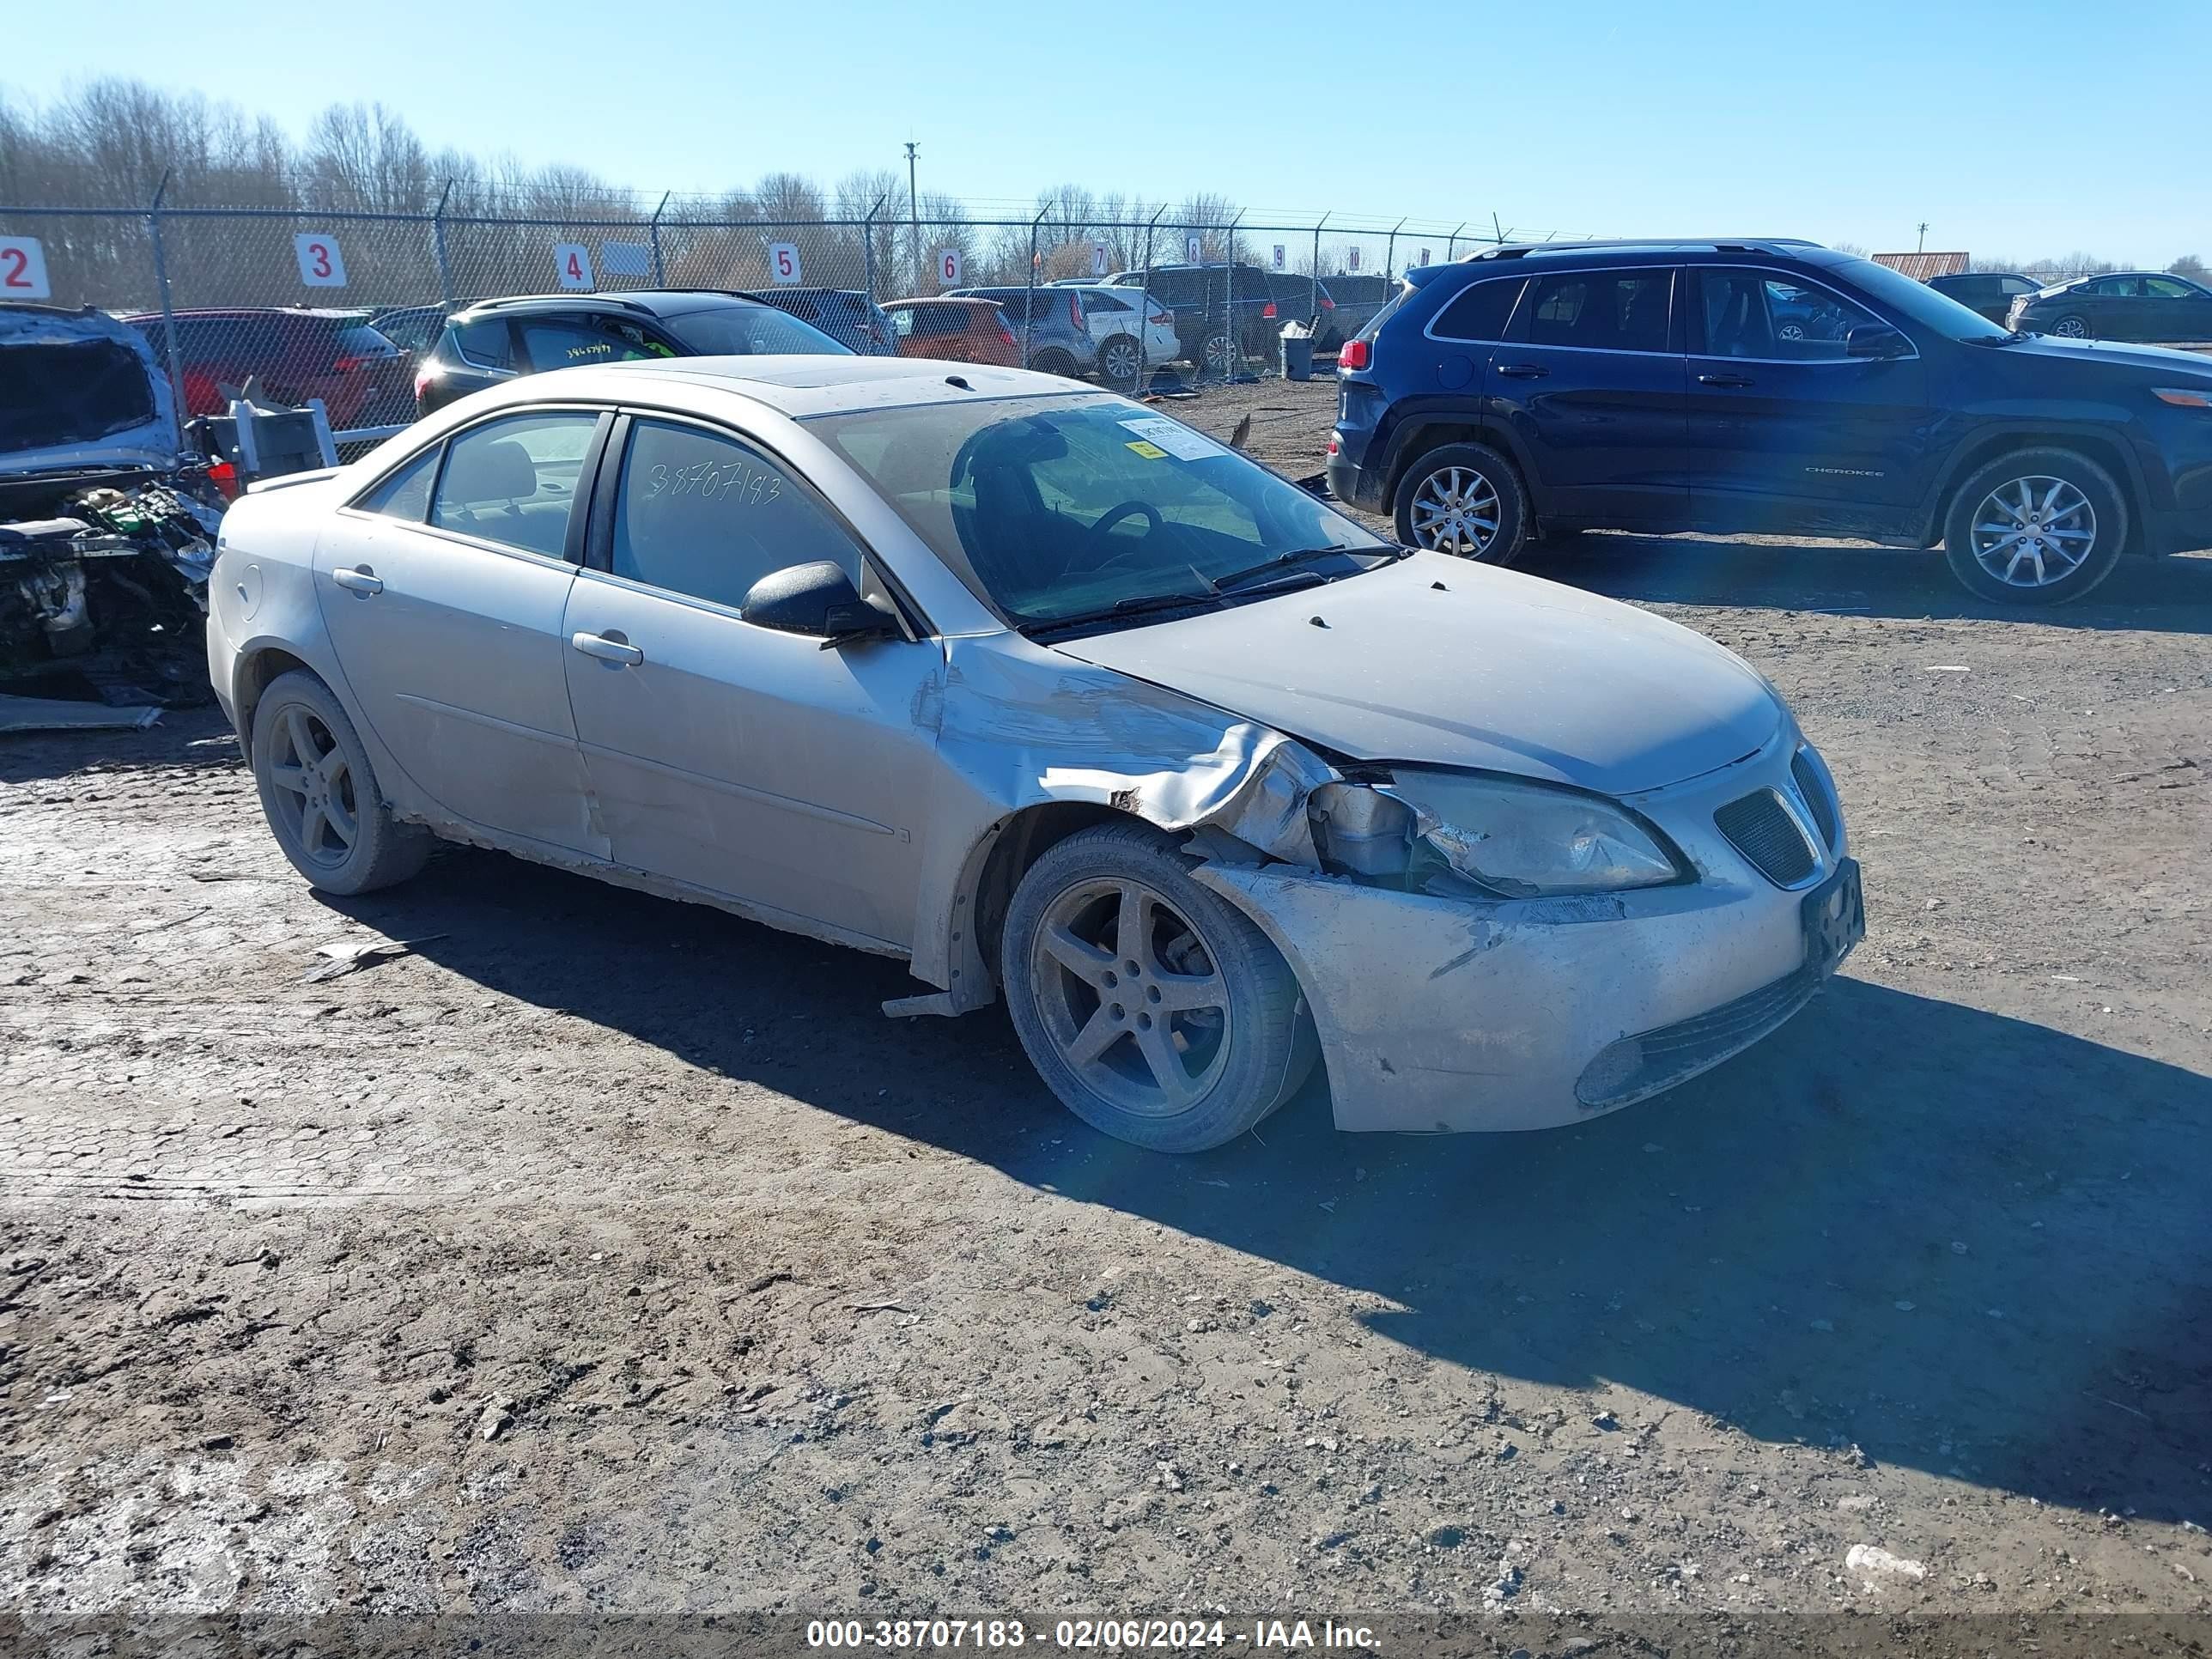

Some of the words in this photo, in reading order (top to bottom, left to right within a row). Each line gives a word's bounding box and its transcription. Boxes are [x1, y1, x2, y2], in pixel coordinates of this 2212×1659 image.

[309, 244, 331, 277] 3
[777, 251, 793, 276] 5
[1097, 247, 1104, 269] 7
[1190, 243, 1198, 262] 8
[1276, 249, 1283, 267] 9
[1350, 252, 1359, 266] 10
[0, 248, 33, 287] 2
[568, 252, 583, 281] 4
[945, 255, 955, 279] 6
[648, 461, 781, 505] 38707183
[1805, 467, 1885, 477] CHEROKEE
